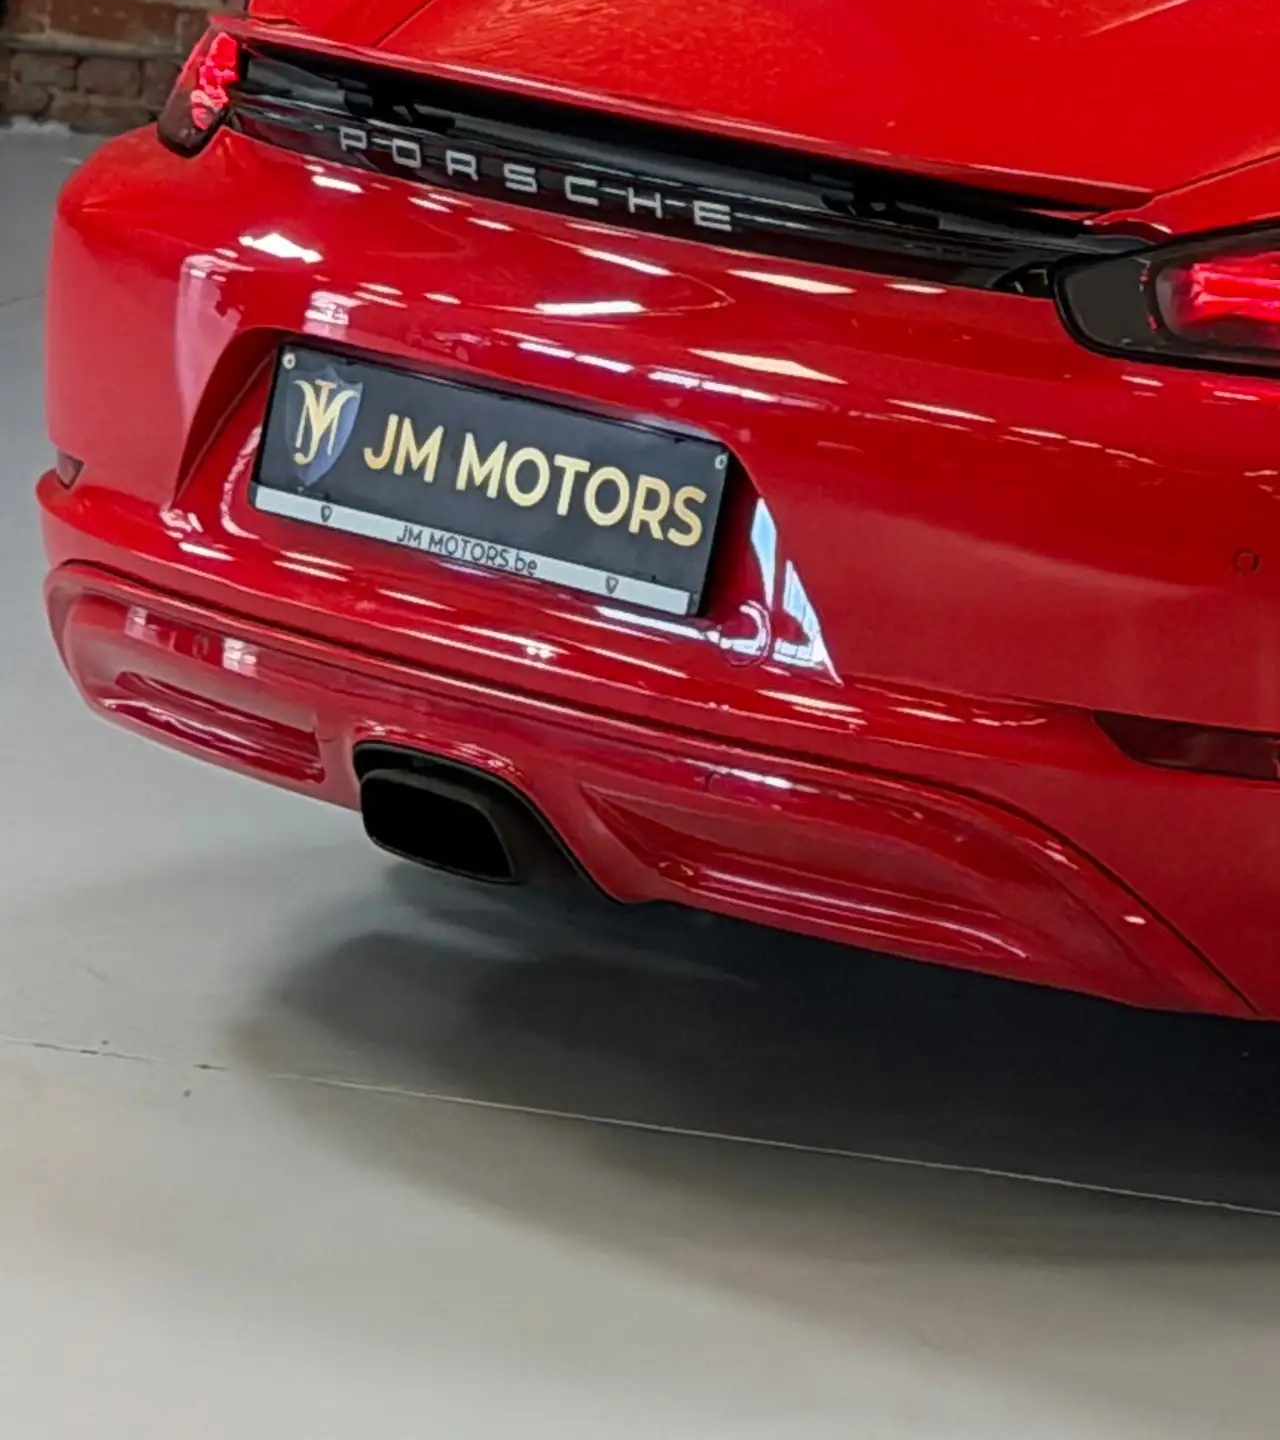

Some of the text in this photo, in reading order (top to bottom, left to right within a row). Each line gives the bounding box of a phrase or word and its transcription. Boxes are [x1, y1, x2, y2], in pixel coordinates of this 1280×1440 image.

[339, 127, 732, 232] PORSCHE
[363, 413, 707, 548] JM MOTORS
[397, 525, 537, 576] JM MOTORS.be
